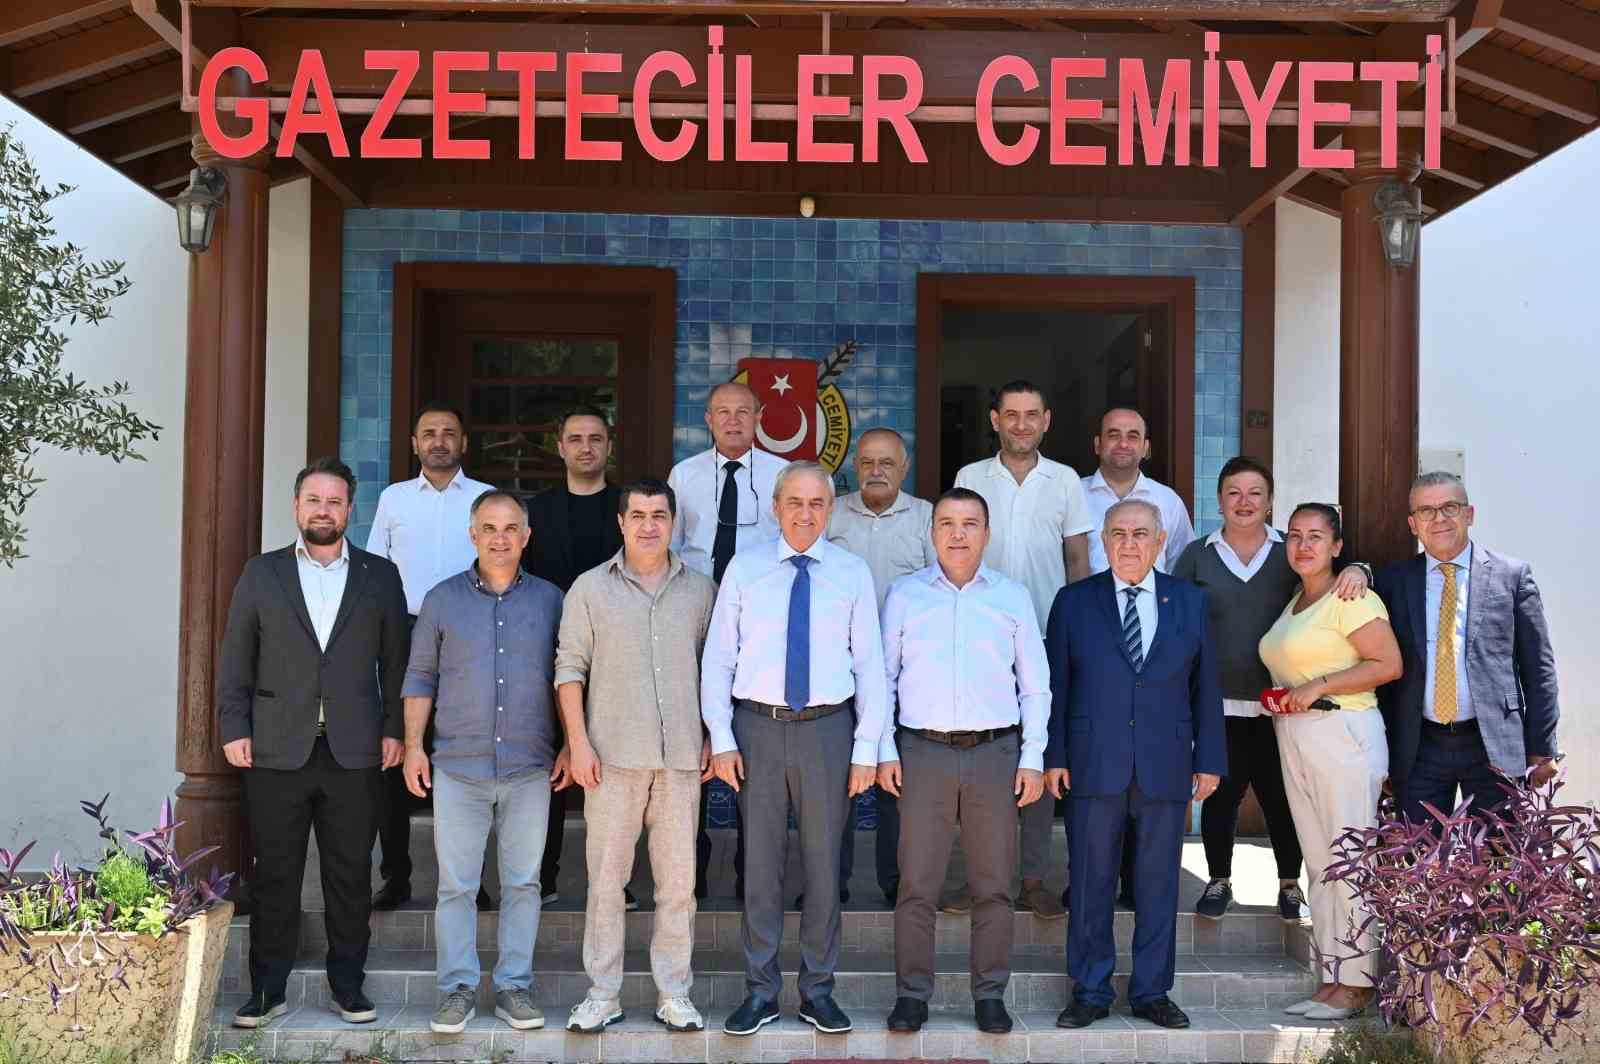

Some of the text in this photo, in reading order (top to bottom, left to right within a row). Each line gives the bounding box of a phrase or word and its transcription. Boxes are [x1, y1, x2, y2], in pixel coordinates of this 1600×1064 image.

[198, 25, 1442, 170] GAZETECİLER CEMİYETİ
[821, 394, 847, 469] CEMİYETİ
